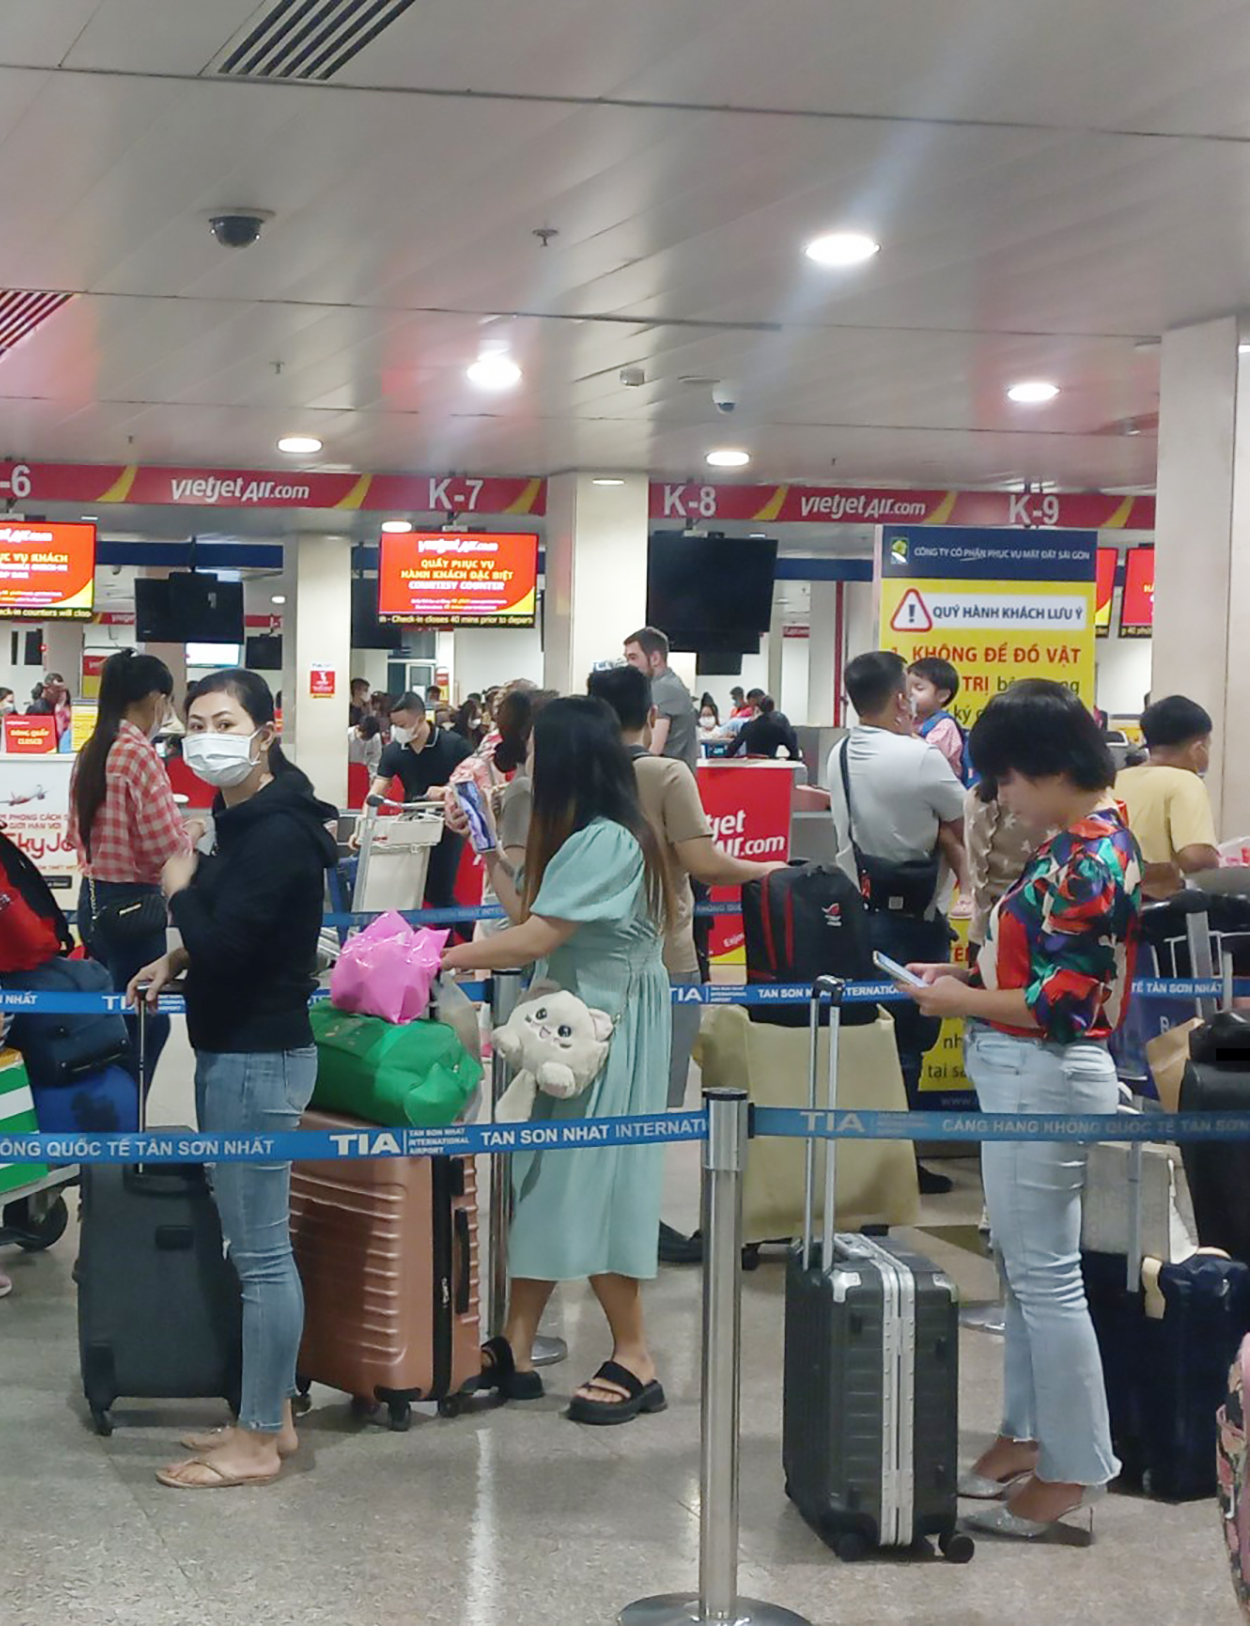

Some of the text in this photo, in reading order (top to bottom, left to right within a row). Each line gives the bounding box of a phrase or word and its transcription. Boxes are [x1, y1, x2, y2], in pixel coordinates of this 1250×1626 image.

[428, 478, 482, 512] K-7
[664, 486, 716, 518] K-8
[1009, 494, 1059, 525] K-9
[939, 547, 949, 556] TY
[933, 603, 1084, 620] QUÝ HÀNH KHÁCH LƯU Ý
[913, 646, 977, 663] KHÔNG
[1046, 646, 1081, 668] VẬT
[963, 676, 990, 694] TRỊ
[5, 991, 38, 1004] NHẤT
[758, 989, 779, 998] TAN
[781, 988, 803, 997] SON
[480, 1118, 707, 1146] TAN SON NHAT INTERNATI
[800, 1111, 866, 1133] TIA
[48, 1136, 101, 1158] QUỐC
[106, 1135, 130, 1157] TẾ
[136, 1136, 173, 1157] TÂN
[178, 1139, 220, 1157] SƠN
[224, 1134, 274, 1156] NHẤT
[329, 1132, 401, 1156] TIA
